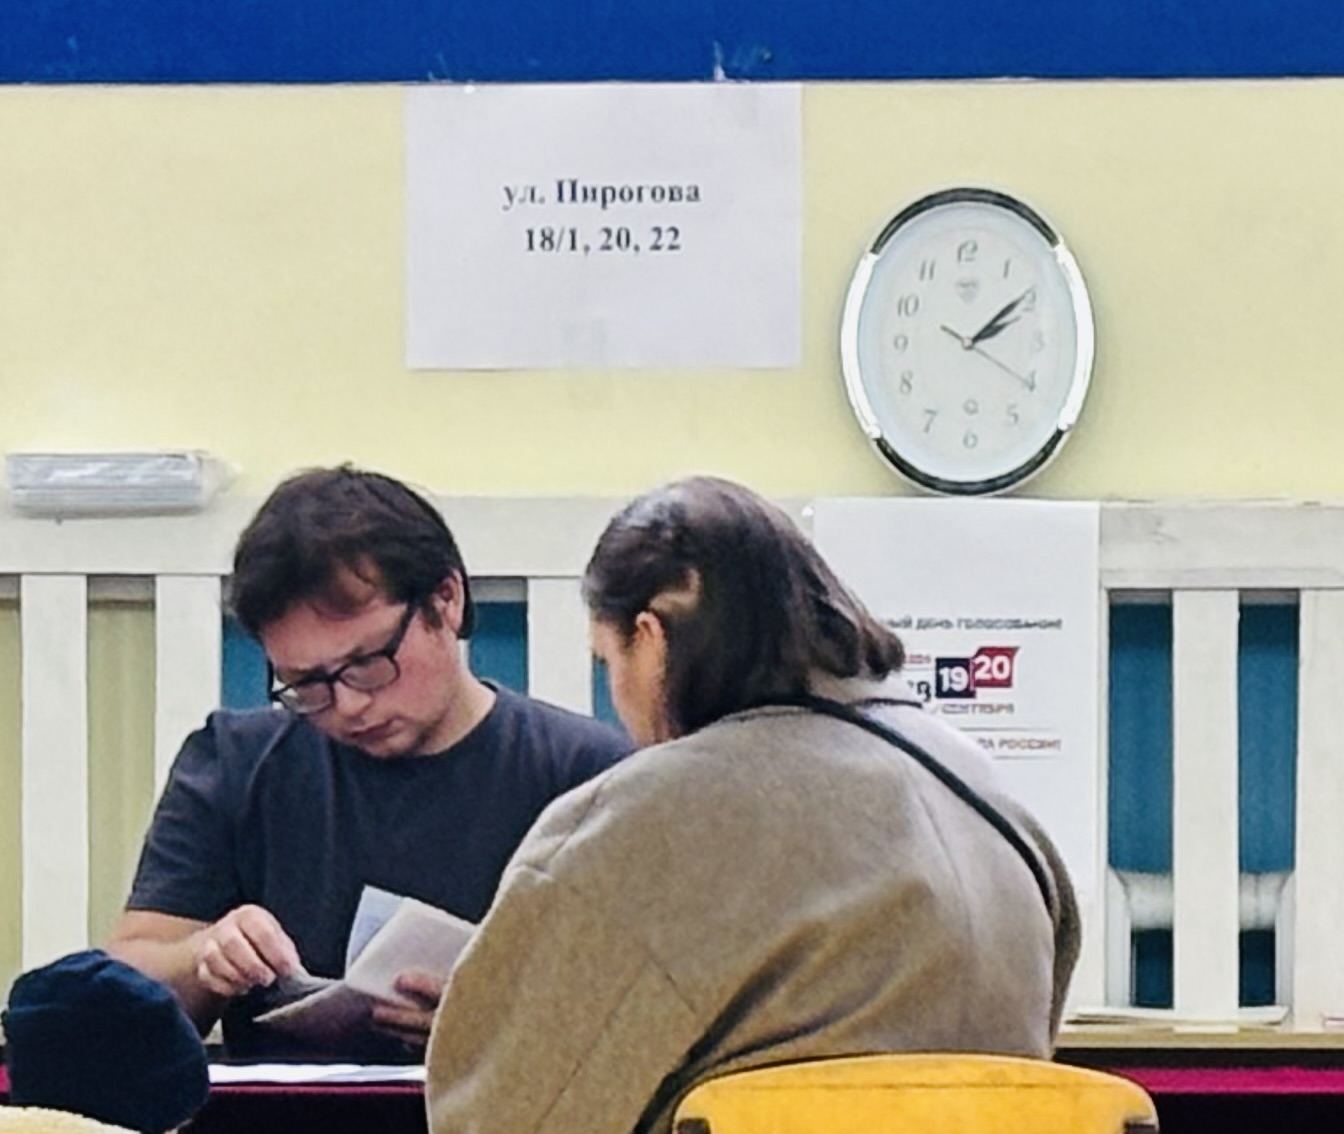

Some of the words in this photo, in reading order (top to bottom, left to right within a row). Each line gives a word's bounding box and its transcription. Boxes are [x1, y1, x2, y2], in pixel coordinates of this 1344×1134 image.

[503, 185, 545, 211] ул.
[556, 179, 701, 211] Пирогова
[525, 226, 591, 256] 18/1,
[599, 226, 641, 254] 20,
[649, 226, 681, 252] 22
[940, 667, 969, 692] 19
[974, 655, 1010, 680] 20
